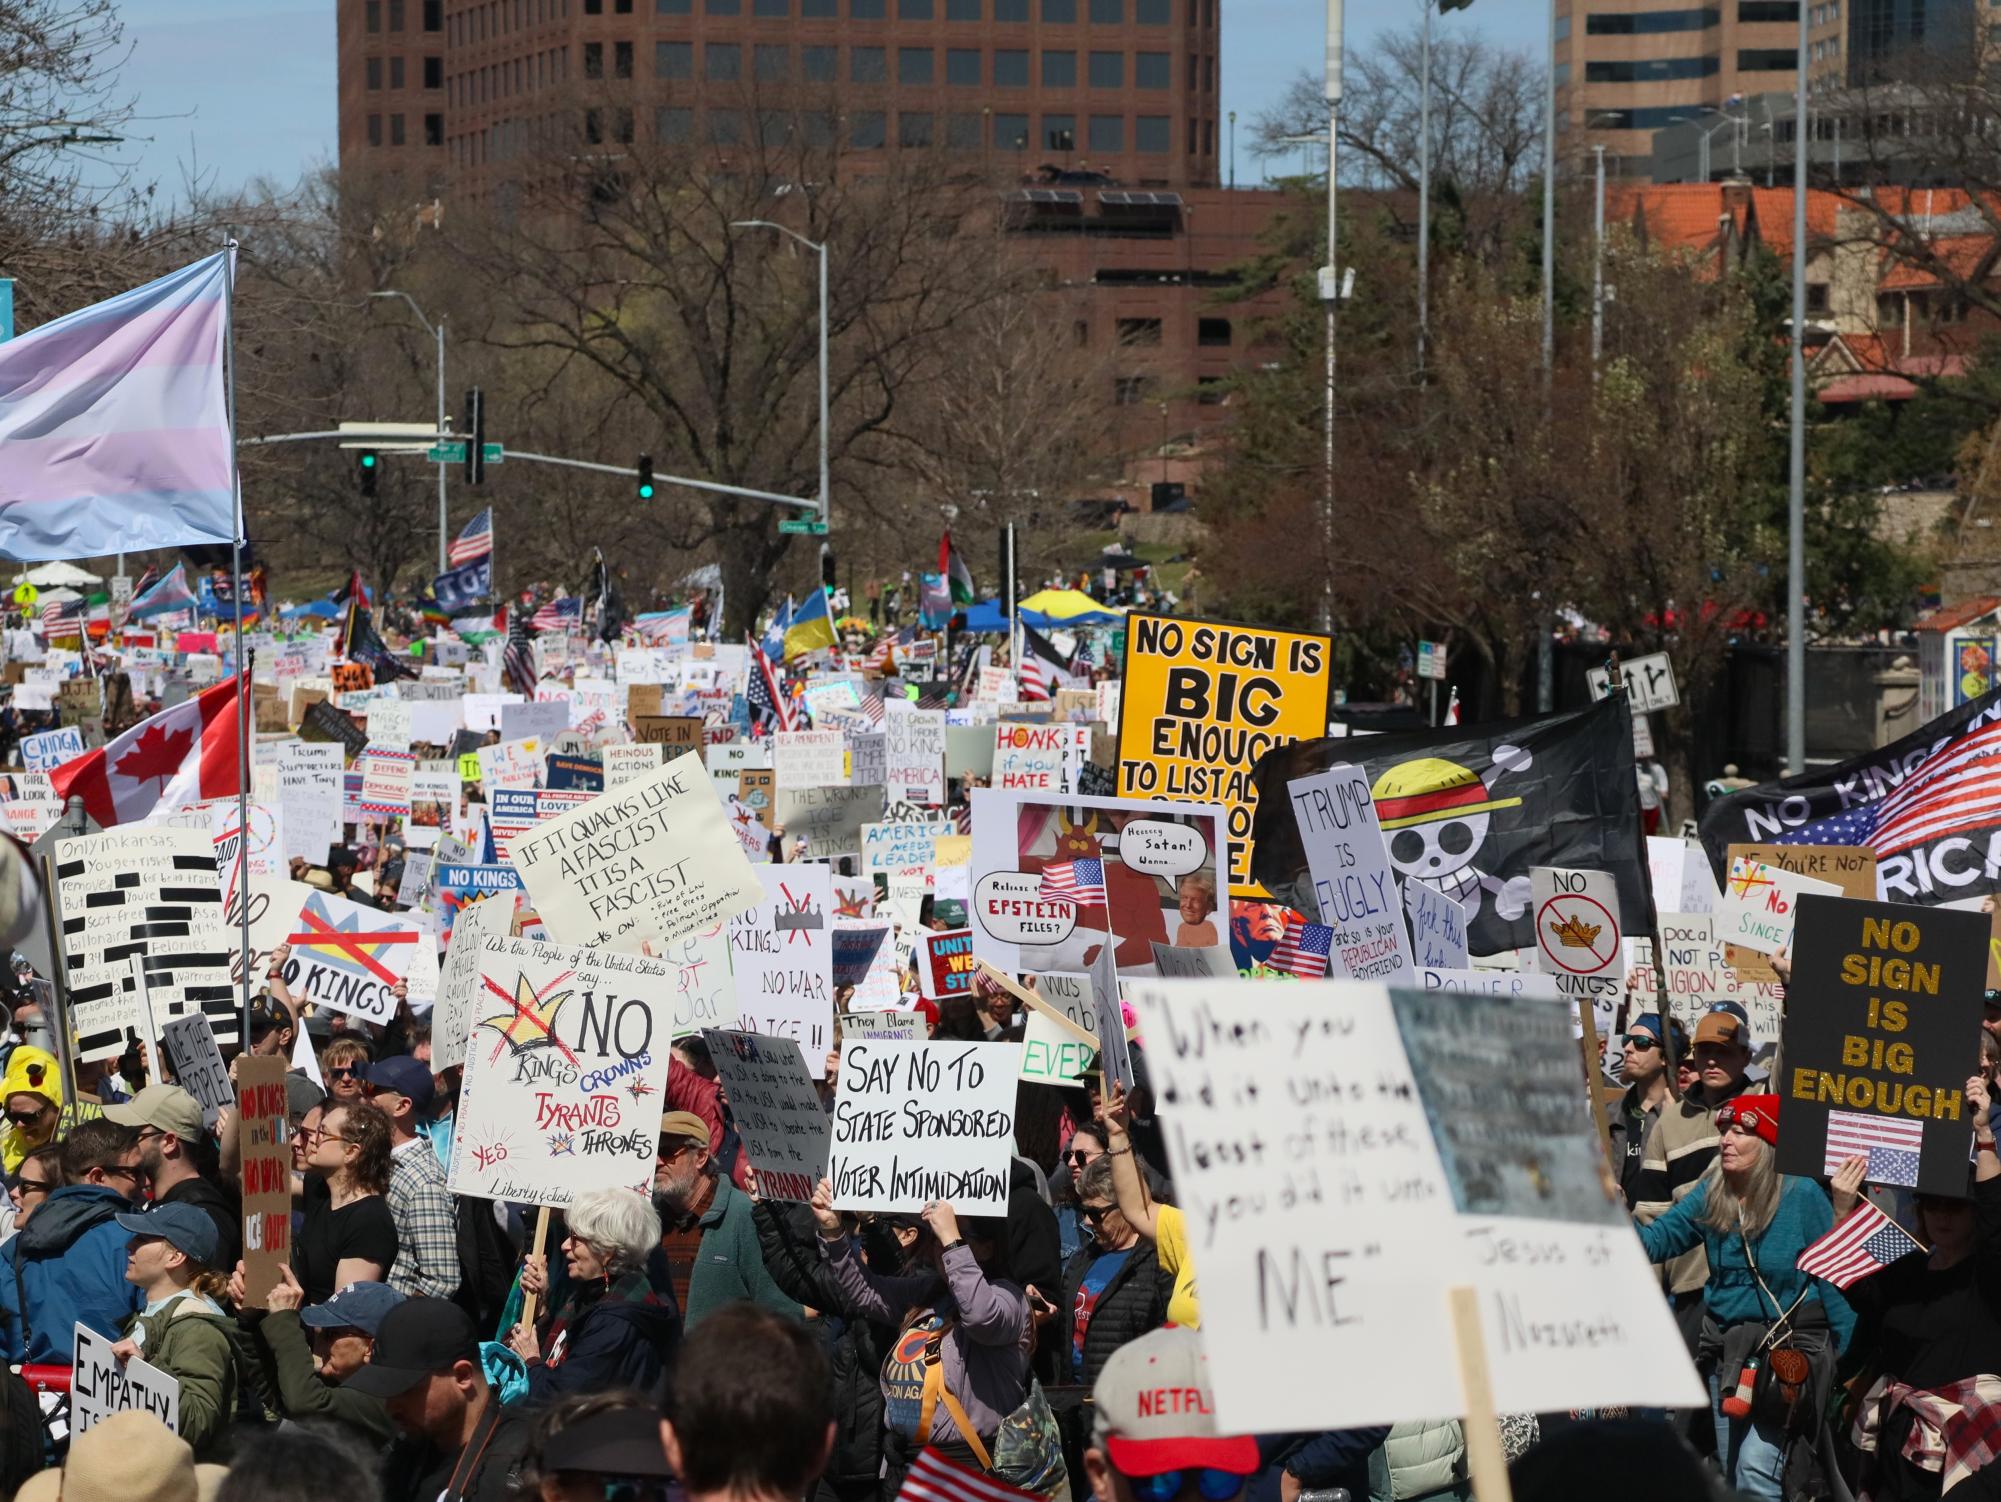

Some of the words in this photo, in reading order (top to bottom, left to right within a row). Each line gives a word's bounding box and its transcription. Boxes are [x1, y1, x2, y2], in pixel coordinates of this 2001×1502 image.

[1135, 619, 1184, 658] NO
[1190, 628, 1277, 670] SIGN
[1288, 640, 1322, 675] IS
[1164, 667, 1284, 727] BIG
[23, 732, 80, 759] CHINGA
[638, 725, 668, 743] VOTE
[677, 725, 691, 741] IN
[887, 738, 905, 754] NO
[910, 738, 943, 755] KING
[997, 727, 1063, 750] HONK
[609, 747, 655, 759] HEINOUS
[611, 760, 655, 772] ACTIONS
[729, 750, 744, 759] NO
[855, 750, 886, 768] IMPE
[1003, 754, 1019, 771] if
[1024, 758, 1056, 772] you
[24, 774, 49, 787] GIRL,
[373, 763, 408, 775] DEFEND
[888, 768, 942, 785] AMERICA
[1003, 773, 1050, 789] HATE
[1122, 761, 1158, 792] TO
[1166, 765, 1225, 799] LIST
[23, 790, 46, 801] LOOK
[364, 781, 410, 794] DEMOCRACY
[495, 793, 509, 804] IN
[511, 794, 535, 805] OUR
[495, 805, 534, 814] AMERICA
[518, 841, 540, 867] IF
[543, 828, 567, 856] IT
[569, 795, 640, 842] QUACKS
[640, 770, 690, 809] LIKE
[541, 801, 570, 811] LOVE
[807, 806, 844, 826] ICE
[1293, 778, 1371, 833] TRUMP
[1743, 796, 1811, 842] NO
[560, 856, 577, 880] A
[573, 806, 671, 870] FASCIST
[810, 825, 831, 840] IS
[867, 823, 953, 844] AMERICA
[1145, 838, 1192, 852] Satan!
[62, 838, 97, 858] Only
[101, 835, 118, 852] in
[890, 841, 931, 852] NEEDS
[1334, 842, 1356, 869] IS
[574, 872, 598, 897] IT
[601, 862, 627, 887] IS
[630, 855, 645, 875] A
[900, 866, 926, 876] NOT
[1835, 854, 1869, 873] NOT
[449, 869, 470, 885] NO
[473, 869, 517, 887] KINGS
[588, 856, 691, 922] FASCIST
[1552, 871, 1587, 893] NO
[64, 896, 84, 911] But
[988, 899, 1072, 920] EPSTEIN
[1315, 870, 1390, 924] FUGLY
[730, 907, 758, 926] NO
[1738, 912, 1784, 944] SINCE
[152, 938, 207, 954] Felonies
[730, 928, 782, 955] KINGS
[1334, 930, 1350, 946] and
[1376, 922, 1395, 935] your
[1861, 917, 1921, 953] NO
[485, 936, 508, 954] We
[511, 938, 529, 957] the
[531, 942, 565, 965] People
[570, 950, 585, 969] of
[586, 950, 602, 968] the
[604, 954, 634, 974] United
[635, 959, 666, 977] States
[948, 956, 973, 974] WE
[1341, 933, 1399, 973] REPUBLICAN
[1669, 948, 1701, 965] NOT
[1351, 953, 1403, 981] BOYFRIEND
[1839, 953, 1942, 995] SIGN
[305, 963, 392, 1016] KINGS
[762, 970, 785, 995] NO
[788, 970, 827, 1001] WAR
[1553, 971, 1619, 996] KINGS
[1754, 996, 1776, 1012] his
[1866, 997, 1909, 1032] IS
[572, 991, 653, 1060] NO
[843, 1014, 875, 1029] They
[887, 1012, 915, 1027] Blame
[1294, 1012, 1356, 1056] you
[862, 1029, 914, 1041] IMMIGRANTS
[466, 1040, 479, 1077] JUSTICE
[1842, 1034, 1915, 1075] BIG
[510, 1053, 579, 1088] KINGS
[580, 1050, 652, 1093] CROWNS
[847, 1045, 900, 1095] SAY
[907, 1047, 941, 1093] NO
[947, 1046, 985, 1091] TO
[241, 1088, 257, 1121] NO
[257, 1083, 286, 1118] KINGS
[1791, 1067, 1962, 1121] ENOUGH
[535, 1092, 621, 1133] TYRANTS
[836, 1100, 897, 1143] STATE
[902, 1099, 1012, 1140] SPONSORED
[472, 1142, 508, 1172] YES
[581, 1128, 653, 1160] THRONES
[1174, 1120, 1267, 1174] least
[244, 1159, 260, 1196] NO
[260, 1156, 285, 1194] WAR
[753, 1168, 814, 1202] TYRANNY
[831, 1154, 885, 1201] VOTER
[889, 1154, 1009, 1203] INTIMIDATION
[487, 1178, 539, 1205] Liberty
[245, 1212, 262, 1250] ICE
[264, 1214, 287, 1253] OUT
[1203, 1191, 1268, 1247] you
[1466, 1227, 1563, 1266] Jesus
[1494, 1288, 1628, 1354] Nazareth
[75, 1333, 170, 1425] EMPATHY
